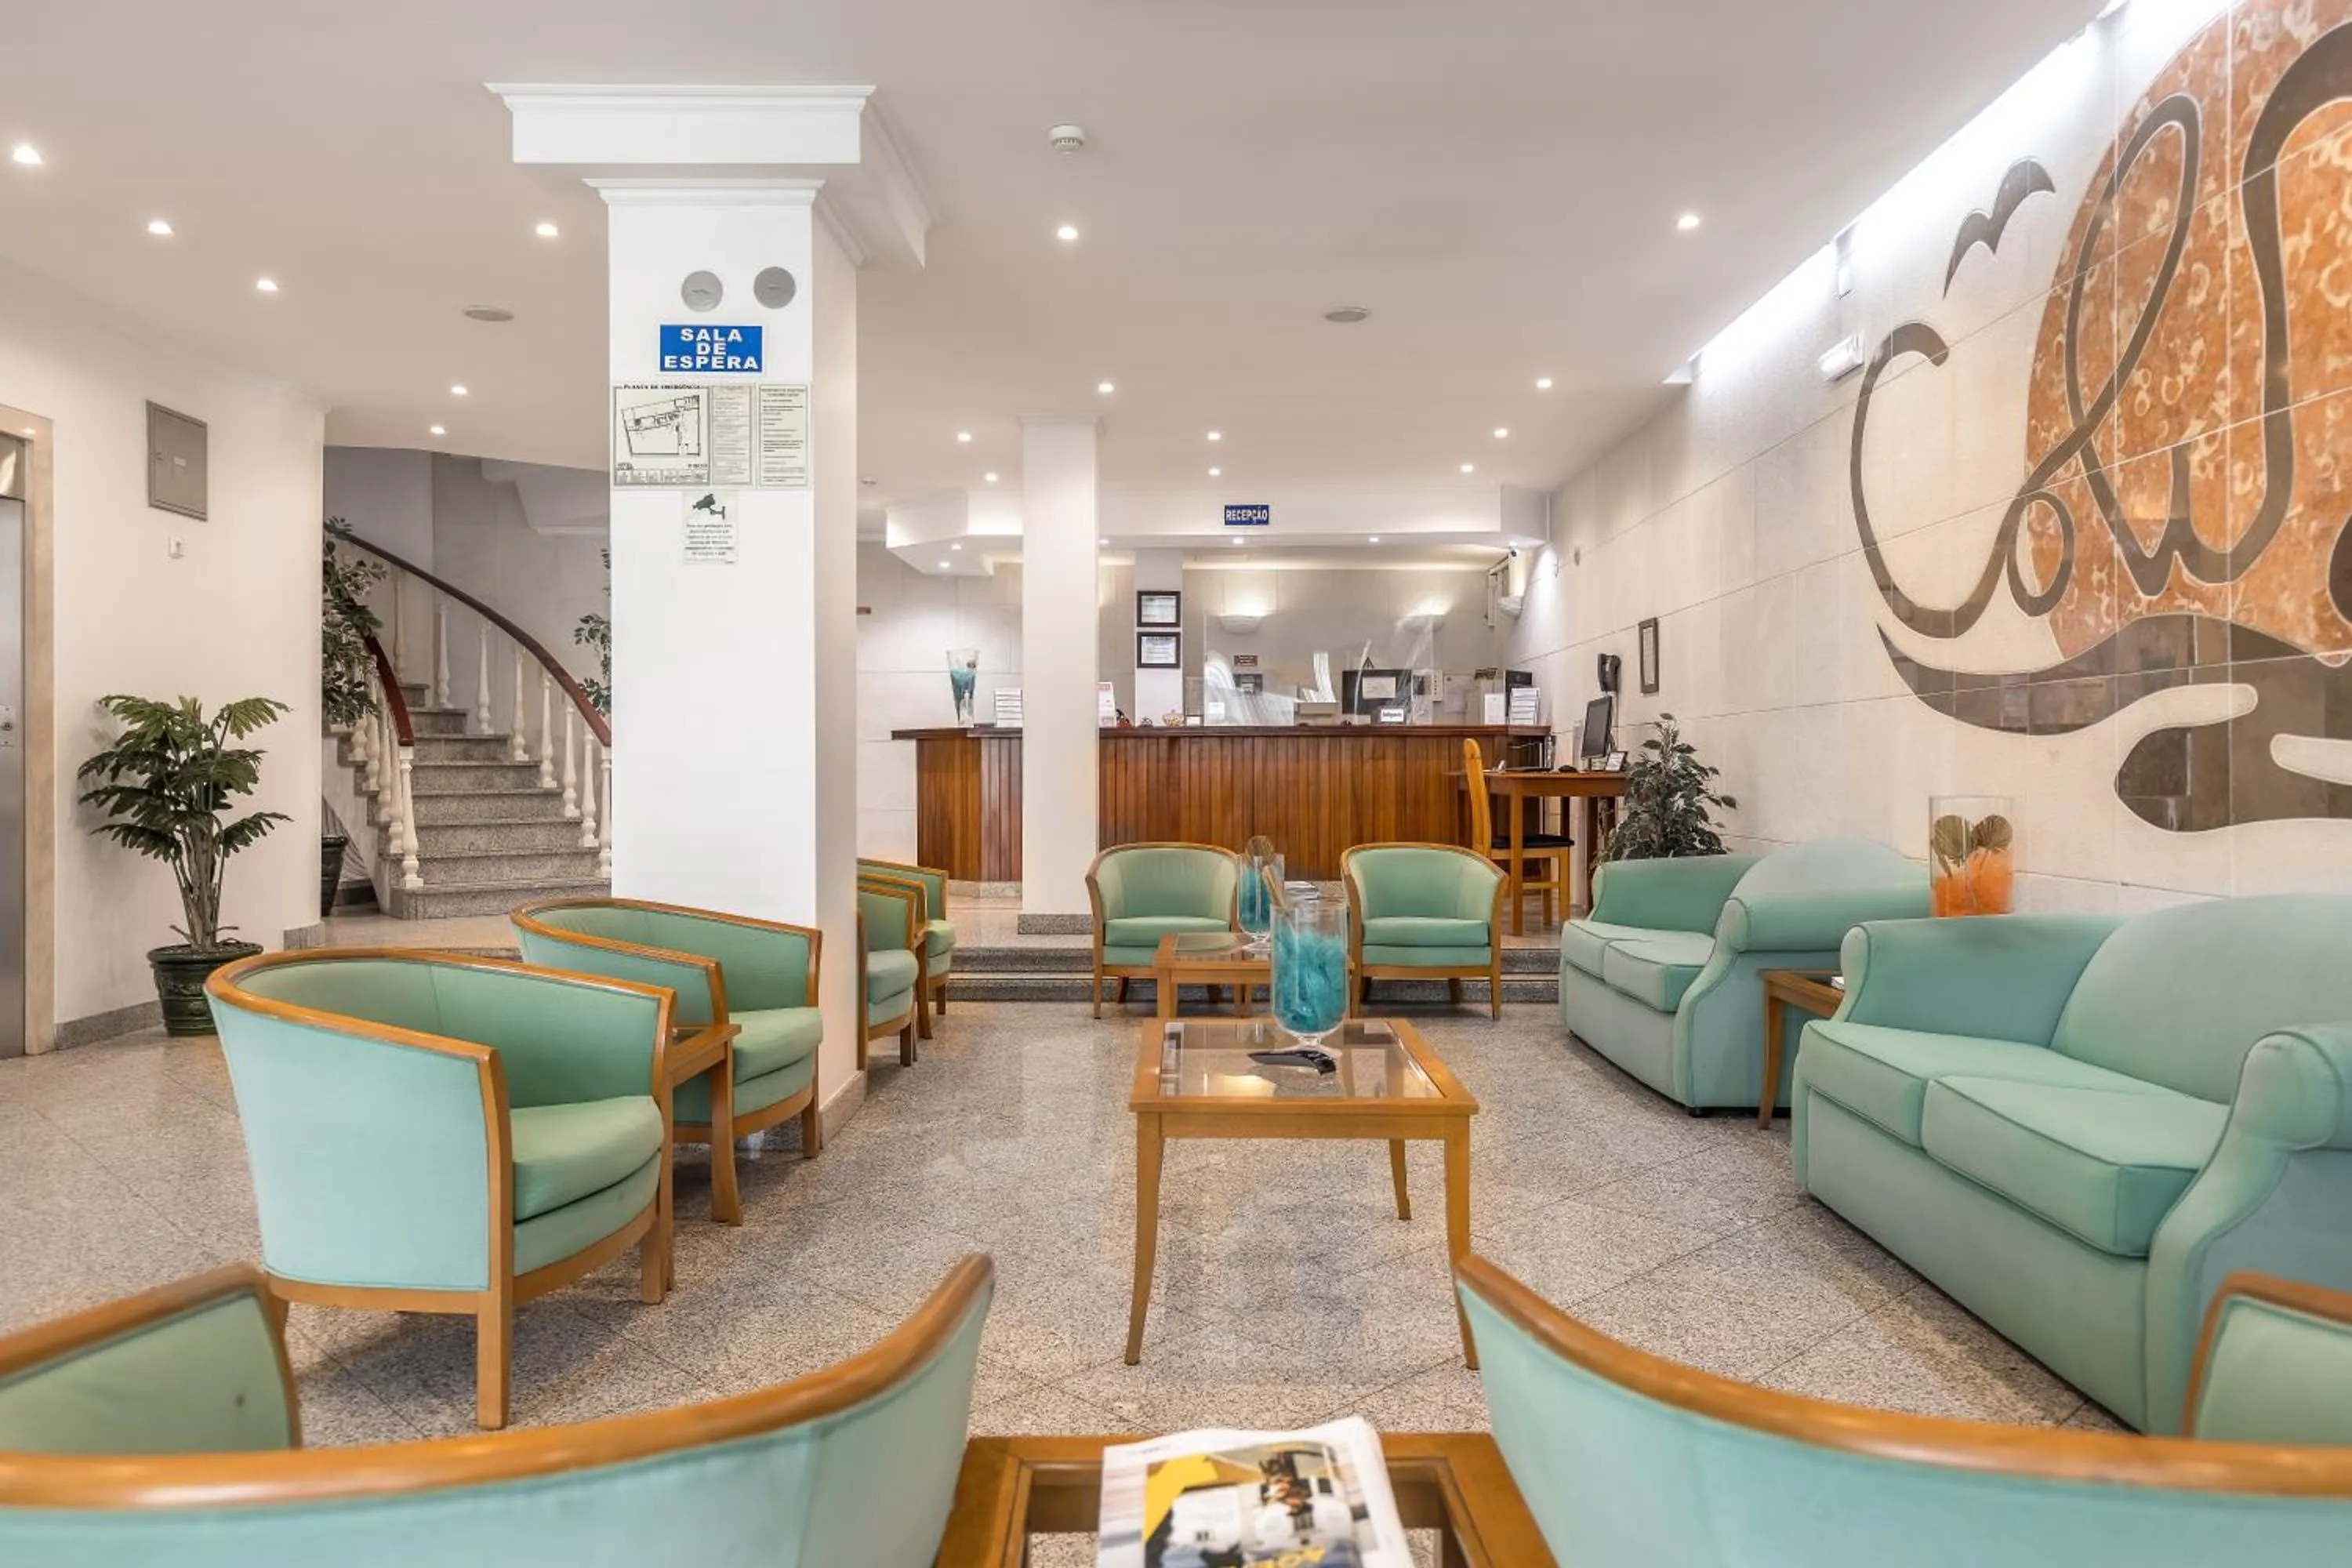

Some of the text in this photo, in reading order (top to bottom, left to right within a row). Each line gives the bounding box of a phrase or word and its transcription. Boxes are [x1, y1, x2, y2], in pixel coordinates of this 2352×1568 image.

[681, 328, 742, 342] SALA
[696, 342, 726, 355] DE
[664, 355, 758, 369] ESPERA
[1225, 506, 1268, 524] RECEPÇÃO
